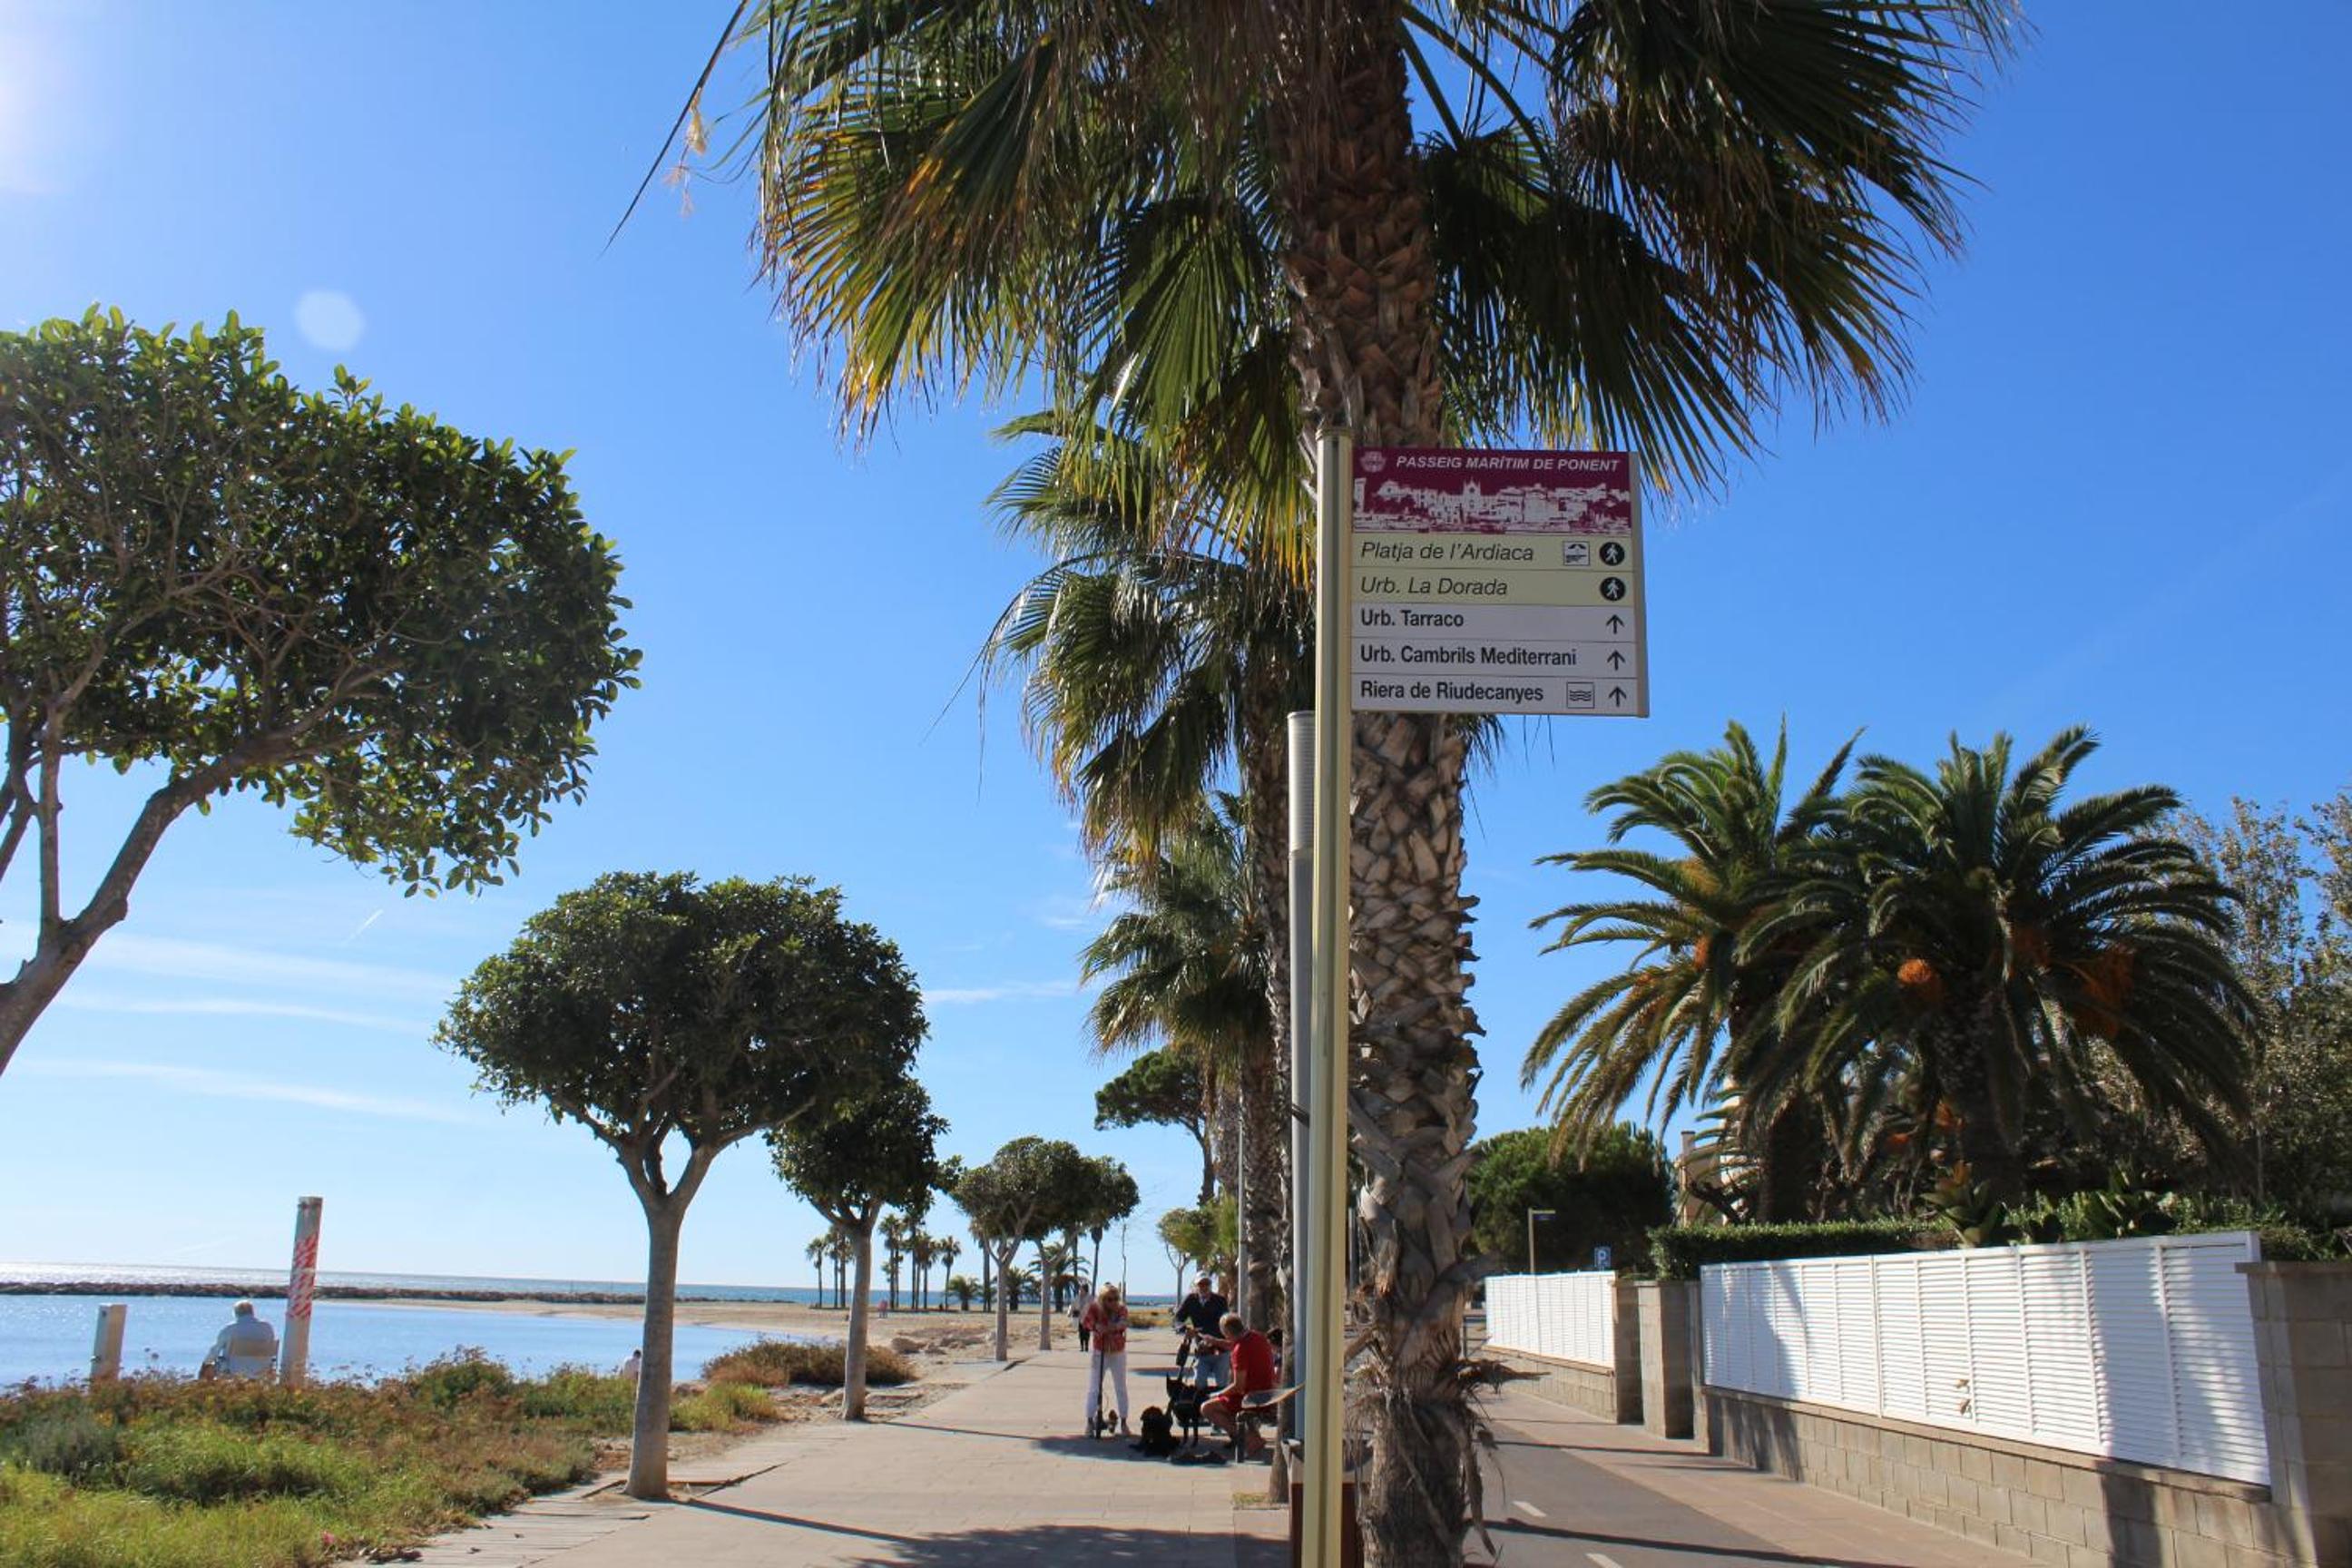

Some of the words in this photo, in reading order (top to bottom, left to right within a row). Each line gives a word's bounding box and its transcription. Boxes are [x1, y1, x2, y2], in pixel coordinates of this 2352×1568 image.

[1396, 456, 1463, 468] PASSEIG
[1465, 456, 1529, 470] MARÍTIM
[1533, 458, 1554, 470] DE
[1557, 459, 1620, 472] PONENT
[1361, 542, 1413, 562] Platja
[1419, 544, 1444, 559] de
[1449, 543, 1534, 561] l'Ardiaca
[1360, 577, 1400, 593] Urb.
[1407, 577, 1431, 593] La
[1437, 578, 1507, 595] Dorada
[1361, 608, 1396, 626] Urb.
[1400, 610, 1464, 627] Tarraco
[1361, 644, 1396, 662] Urb.
[1401, 645, 1475, 664] Cambrils
[1480, 646, 1577, 665] Mediterrani
[1361, 681, 1405, 699] Riera
[1409, 681, 1431, 699] de
[1436, 681, 1544, 704] Riudecanyes
[1598, 1250, 1607, 1265] P
